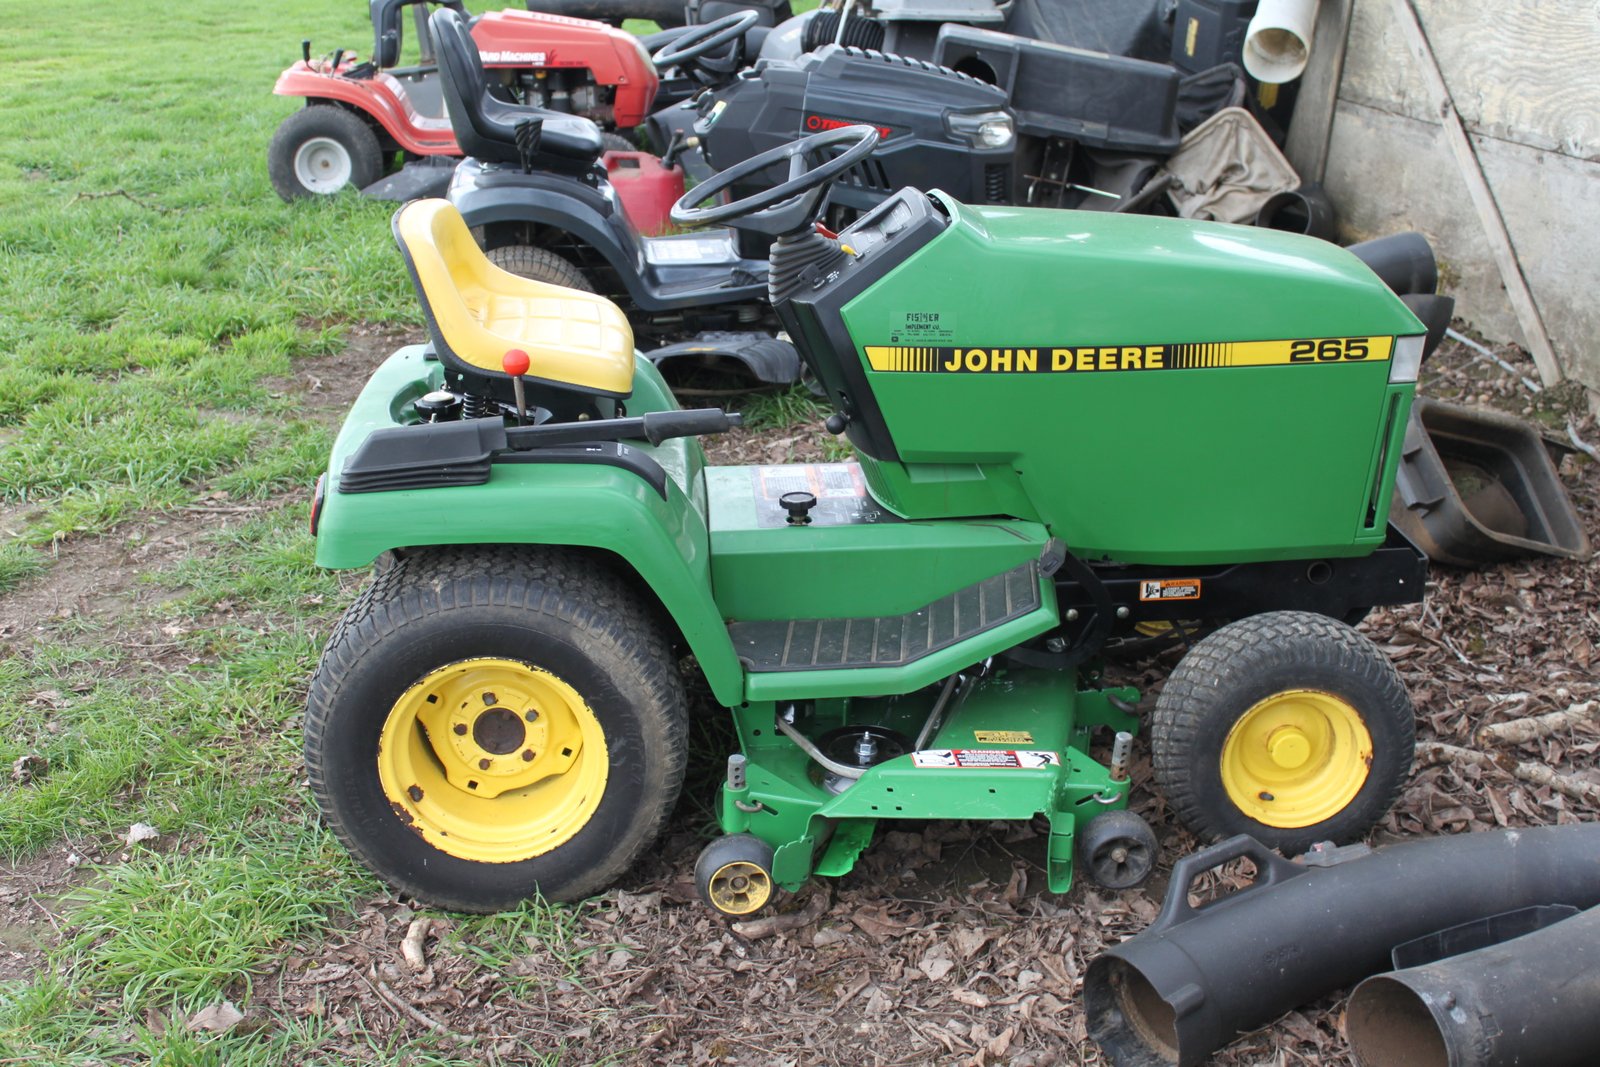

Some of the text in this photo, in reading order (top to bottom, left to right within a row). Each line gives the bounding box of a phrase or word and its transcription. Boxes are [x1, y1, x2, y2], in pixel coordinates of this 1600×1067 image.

[501, 51, 546, 62] MACHINES
[944, 346, 1165, 372] JOHN DEERE
[1289, 338, 1369, 363] 265
